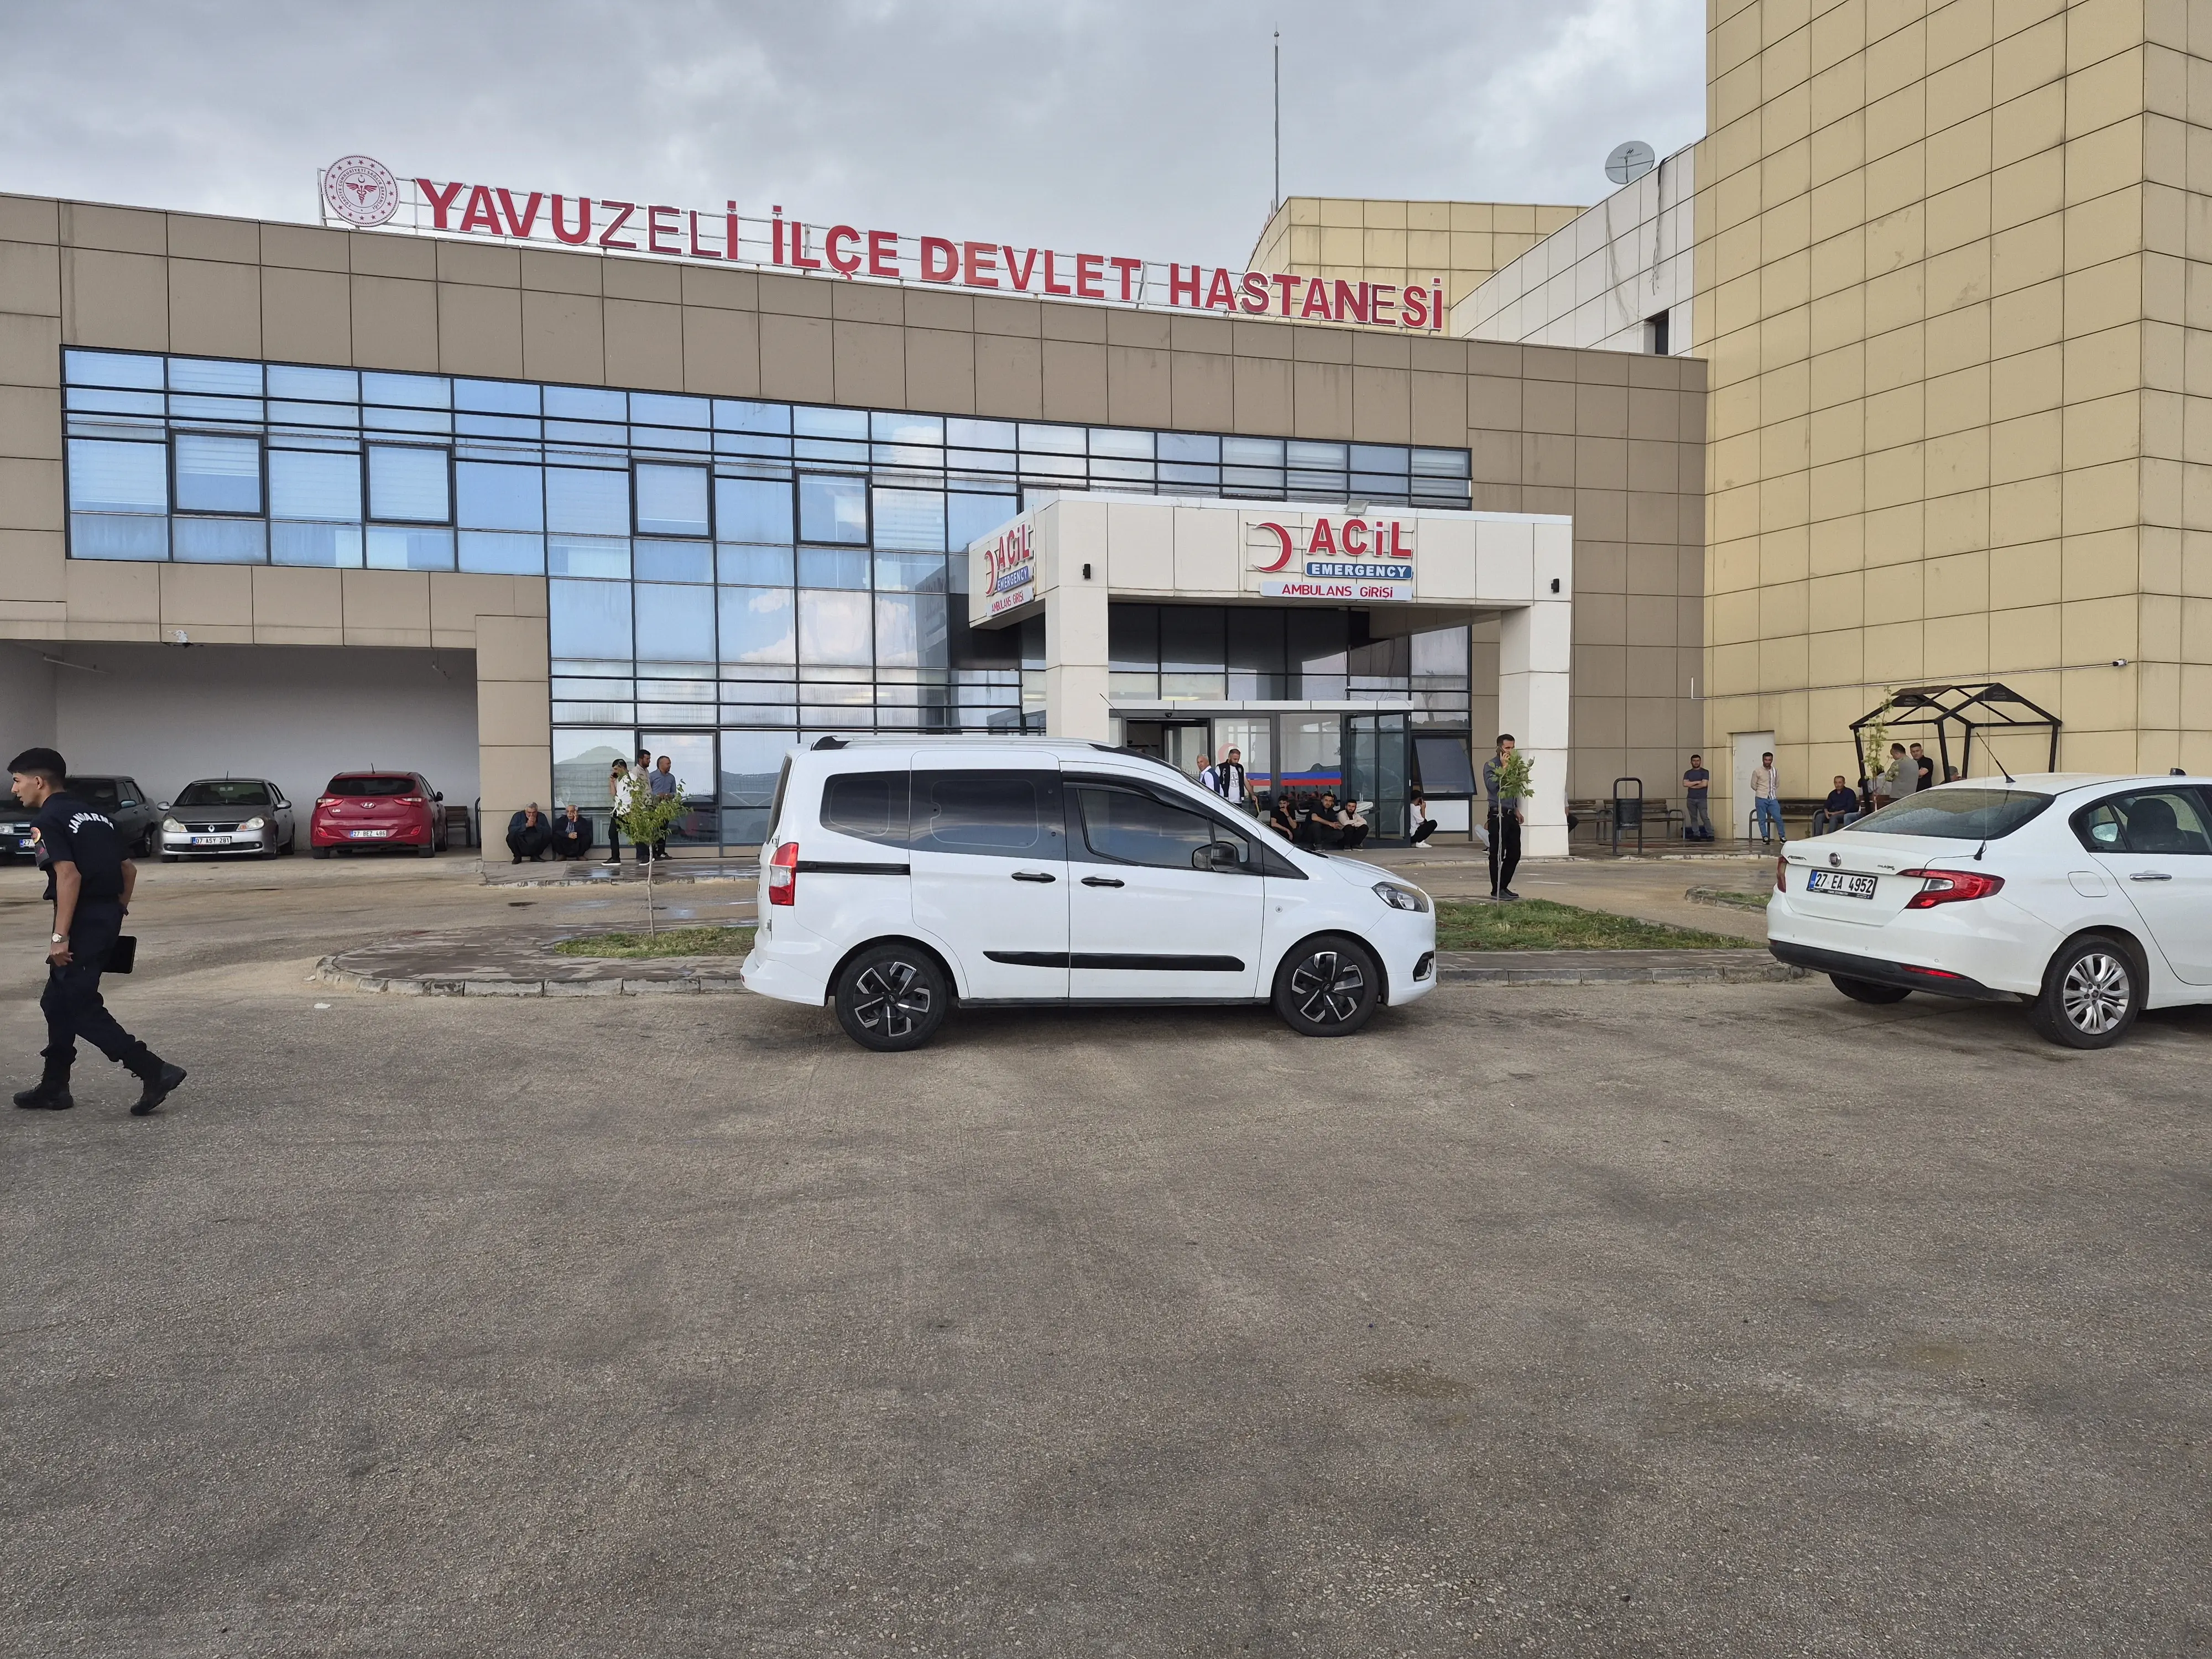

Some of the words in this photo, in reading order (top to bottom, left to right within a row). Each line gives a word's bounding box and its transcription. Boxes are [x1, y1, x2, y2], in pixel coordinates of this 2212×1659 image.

[415, 178, 739, 261] YAVUZELİ
[772, 205, 900, 280] İLÇE
[920, 236, 1142, 301] DEVLET
[1169, 262, 1442, 330] HASTANESİ
[997, 567, 1028, 591] EMERGENCY
[1312, 564, 1407, 577] EMERGENCY
[1281, 584, 1352, 596] AMBULANS
[992, 596, 1011, 613] AMBULANS
[1814, 873, 1828, 887] 27
[1831, 875, 1843, 889] EA
[1848, 877, 1874, 893] 4952
